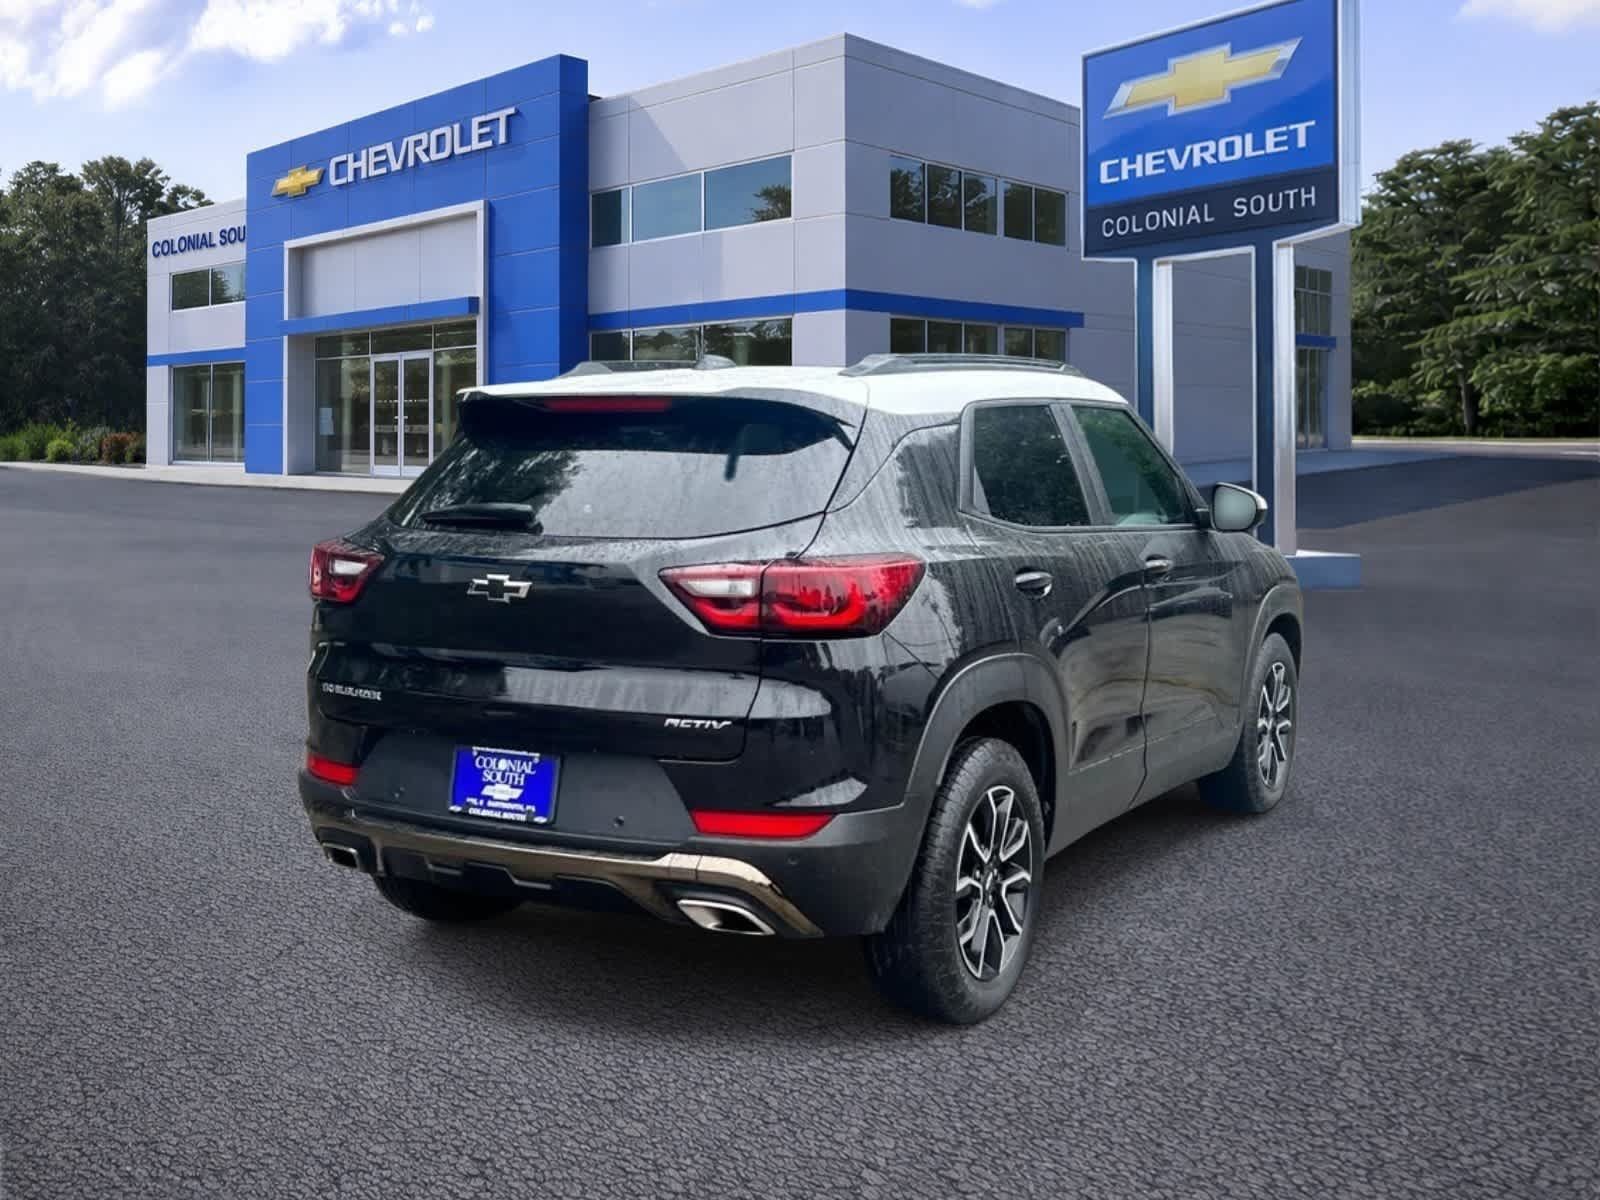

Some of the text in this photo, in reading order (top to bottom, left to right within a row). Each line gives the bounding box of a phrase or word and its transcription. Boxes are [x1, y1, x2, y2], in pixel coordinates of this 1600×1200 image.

[329, 107, 518, 187] CHEVROLET
[1099, 120, 1316, 184] CHEVROLET
[1102, 185, 1316, 238] COLONIAL SOUTH
[152, 231, 216, 258] COLONIAL
[663, 717, 733, 729] ACTIV
[475, 755, 537, 775] COLONIAL
[482, 769, 525, 786] SOUTH
